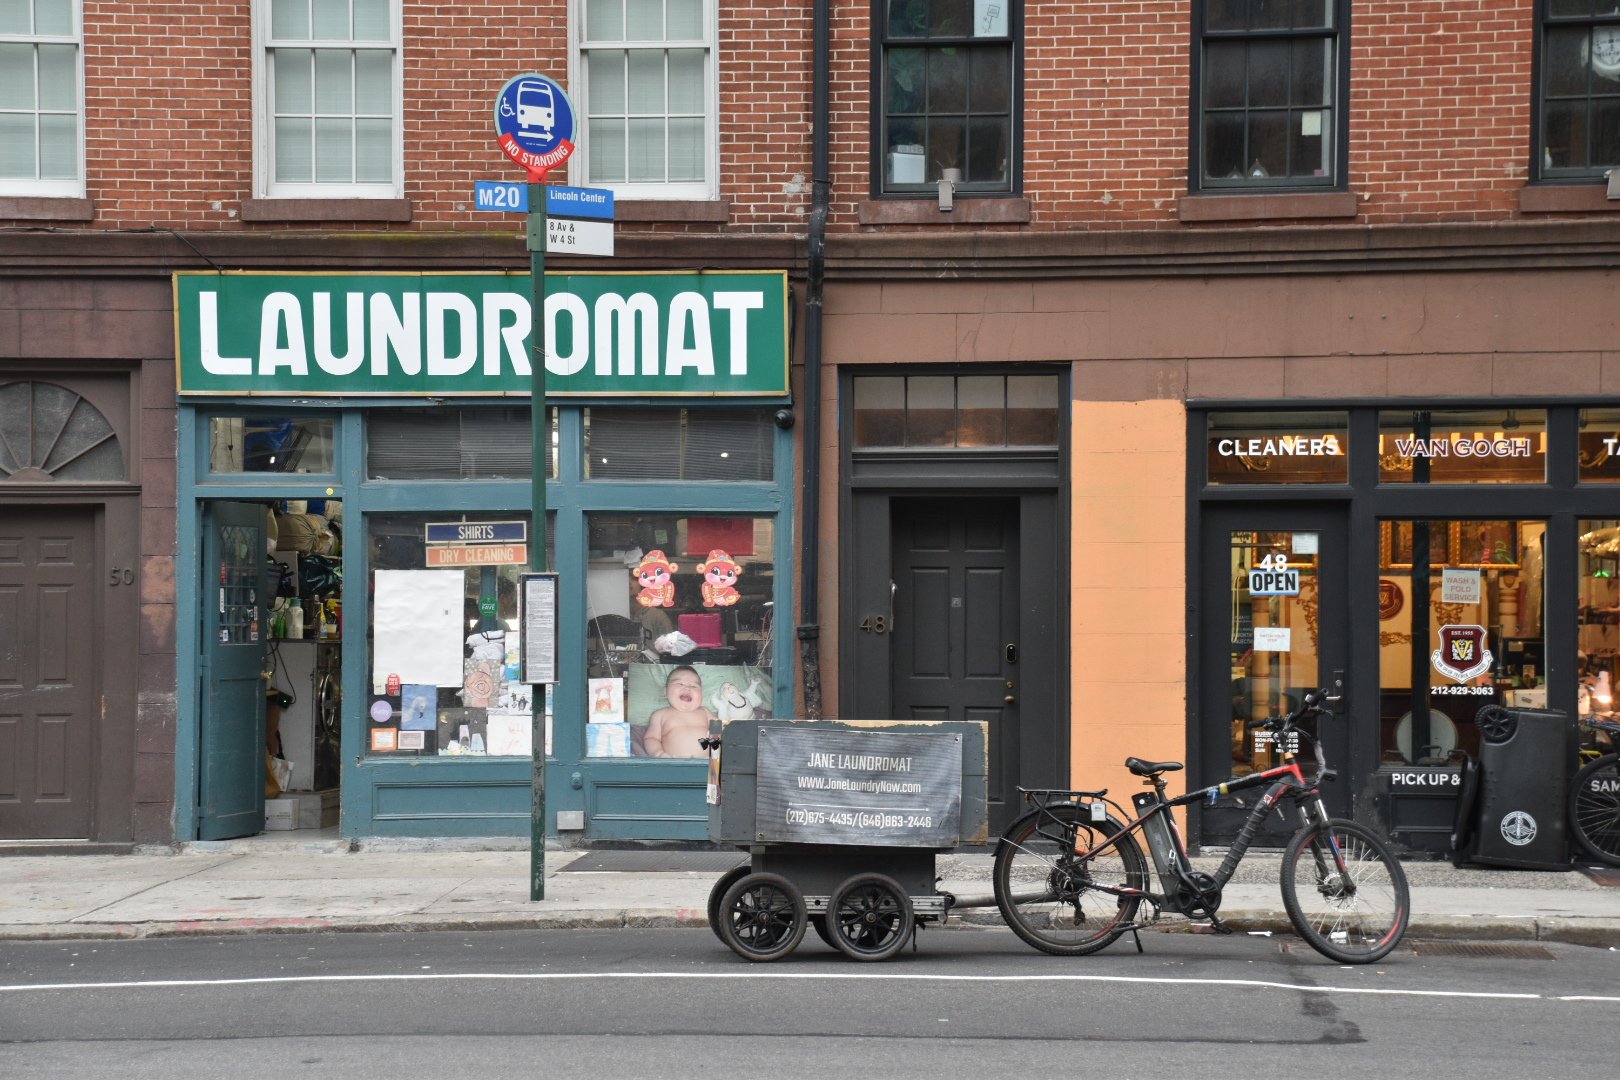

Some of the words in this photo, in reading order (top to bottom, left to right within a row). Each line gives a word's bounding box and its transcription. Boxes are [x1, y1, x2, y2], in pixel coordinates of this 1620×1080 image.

[504, 139, 520, 157] NO
[521, 145, 569, 167] STANDING
[479, 186, 520, 208] M20
[550, 189, 579, 202] Lincoln
[580, 191, 606, 204] Center
[549, 221, 555, 231] 8
[557, 222, 567, 231] Av
[569, 223, 575, 232] &
[549, 234, 558, 243] W
[559, 234, 565, 244] 4
[567, 235, 576, 245] St
[200, 291, 764, 376] LAUNDROMAT
[1218, 438, 1339, 457] CLEANERS
[1395, 438, 1449, 457] VAN
[1452, 438, 1531, 457] GOGH
[1603, 438, 1620, 456] T
[458, 525, 494, 540] SHIRTS
[439, 549, 460, 563] DRY
[465, 547, 514, 563] CLEANING
[1260, 554, 1288, 573] 48
[109, 566, 135, 587] 50
[1252, 573, 1296, 592] OPEN
[1444, 593, 1478, 601] SERVICE
[1450, 585, 1472, 593] FOLD
[859, 615, 886, 633] 48
[1431, 686, 1494, 695] 212-929-3063
[807, 752, 836, 769] JANE
[838, 754, 913, 772] LAUNDROMAT
[797, 776, 922, 794] WWW.JaneLaundryNow.com
[1391, 773, 1426, 786] PICK
[1428, 773, 1449, 786] UP
[1451, 773, 1461, 786] &
